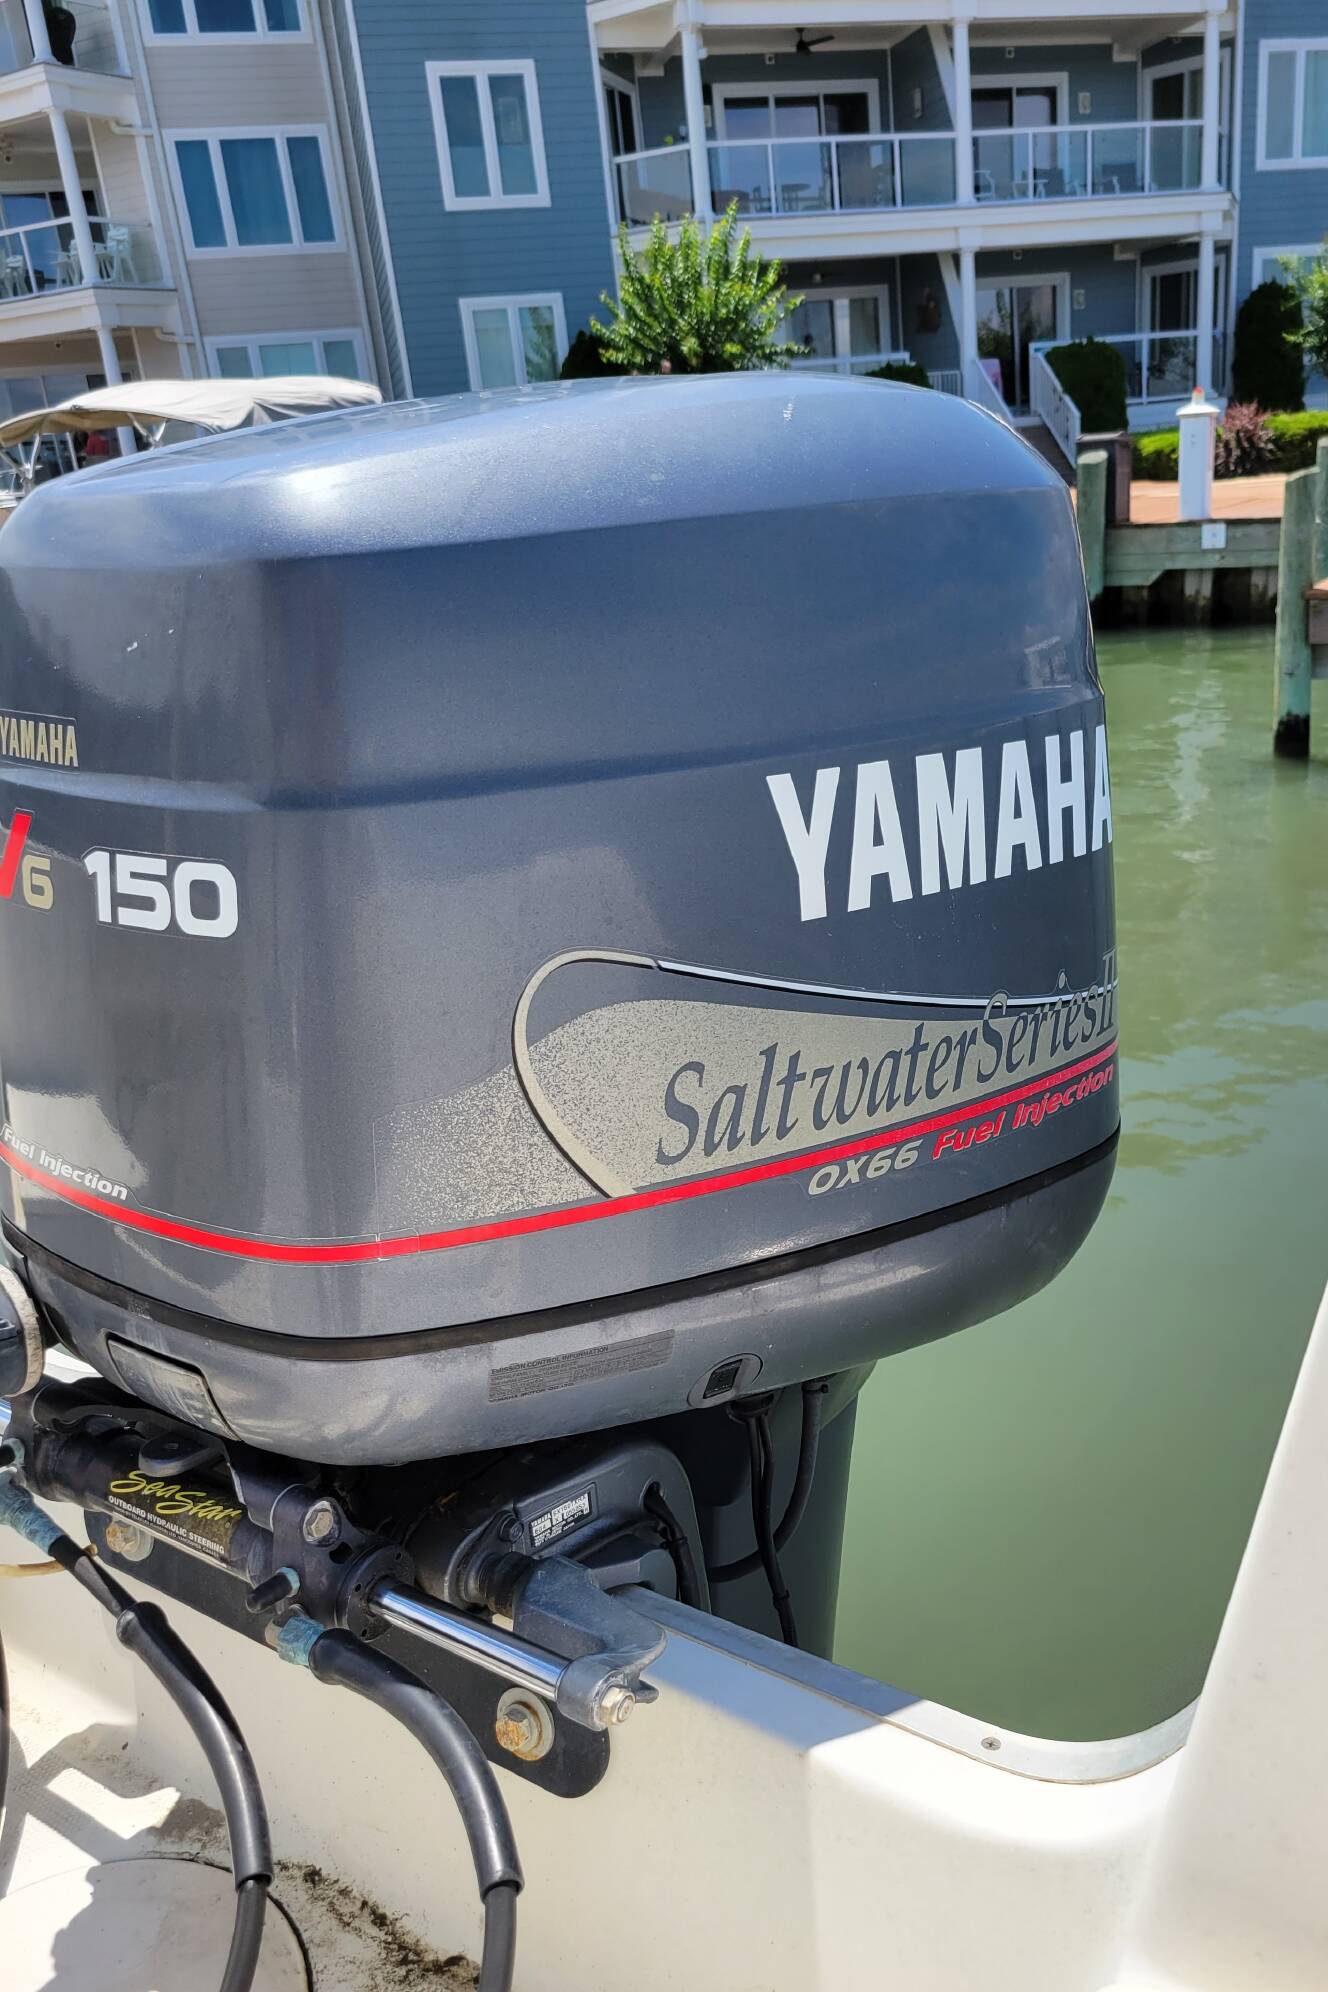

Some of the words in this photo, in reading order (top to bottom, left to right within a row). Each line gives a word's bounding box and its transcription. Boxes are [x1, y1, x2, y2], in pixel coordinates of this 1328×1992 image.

[0, 716, 79, 768] YAMAHA
[765, 724, 1113, 922] YAMAHA
[84, 851, 239, 938] 150
[3, 1128, 35, 1159] Fuel
[39, 1150, 129, 1200] Injection
[807, 1138, 923, 1196] OX66
[932, 1114, 1005, 1160] Fuel
[1011, 1062, 1115, 1130] Injection
[108, 1495, 146, 1518] OUTBOARD
[147, 1513, 187, 1537] HYDRAULIC
[188, 1532, 225, 1554] STEERING
